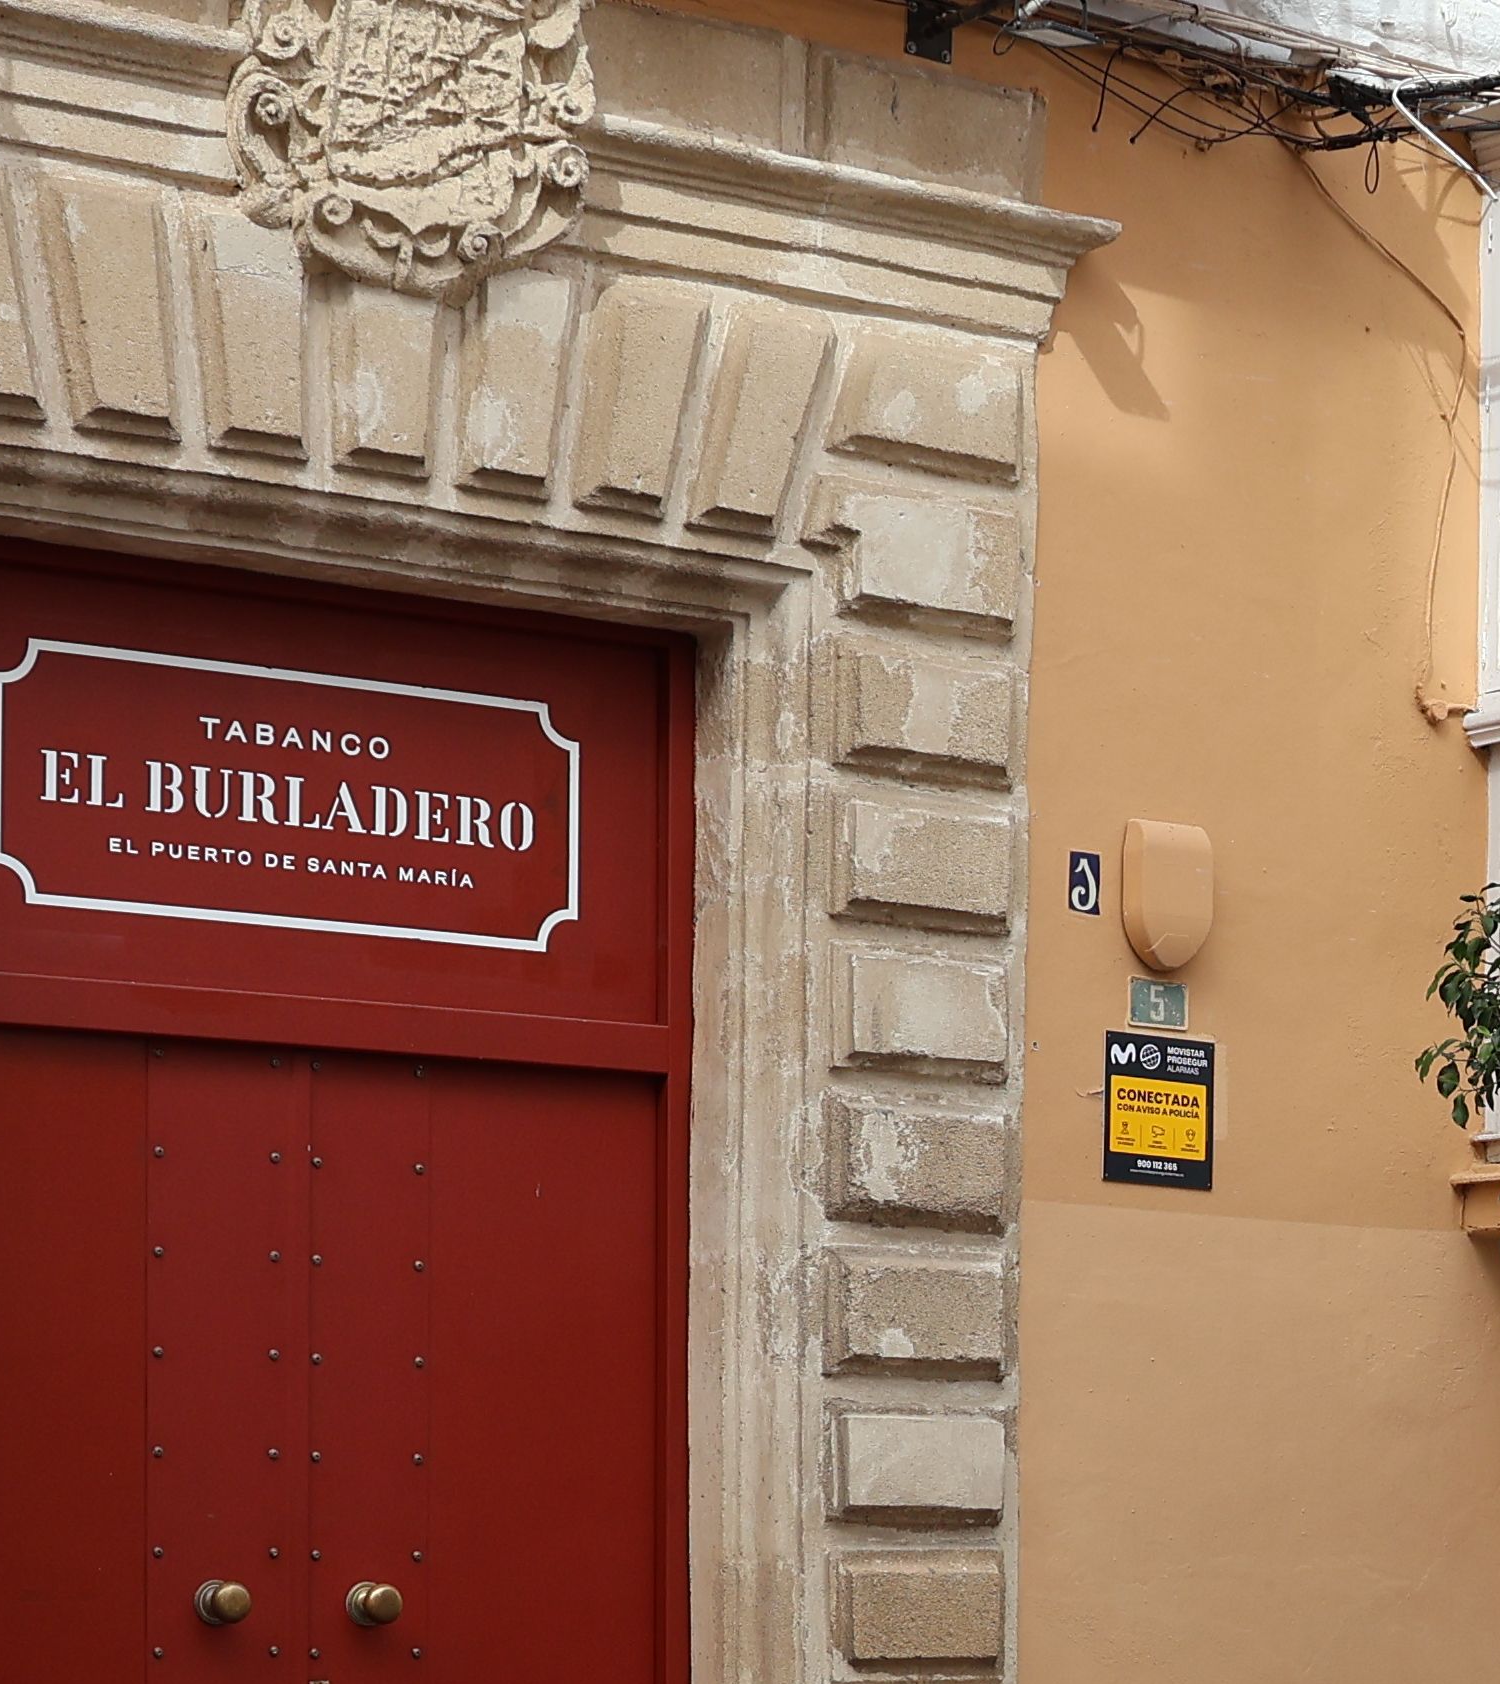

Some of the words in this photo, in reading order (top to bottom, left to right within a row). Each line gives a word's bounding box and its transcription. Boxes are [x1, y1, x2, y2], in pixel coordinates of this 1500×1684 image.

[199, 716, 389, 759] TABANCO
[40, 749, 123, 807] EL
[145, 760, 534, 851] BURLADERO
[109, 837, 138, 854] EL
[151, 841, 251, 865] PUERTO
[265, 853, 296, 870] DE
[307, 857, 387, 880] SANTA
[399, 866, 474, 889] MARÍA
[1150, 985, 1164, 1022] 5
[1166, 1046, 1205, 1058] MOVISTAR
[1166, 1055, 1208, 1068] PROSEGUR
[1166, 1065, 1200, 1076] ALARMAS
[1117, 1088, 1200, 1109] CONECTADA
[1117, 1103, 1135, 1112] CON
[1136, 1105, 1161, 1115] AVISO
[1162, 1108, 1168, 1116] A
[1169, 1108, 1200, 1120] POLICÍA
[1137, 1159, 1152, 1169] 900
